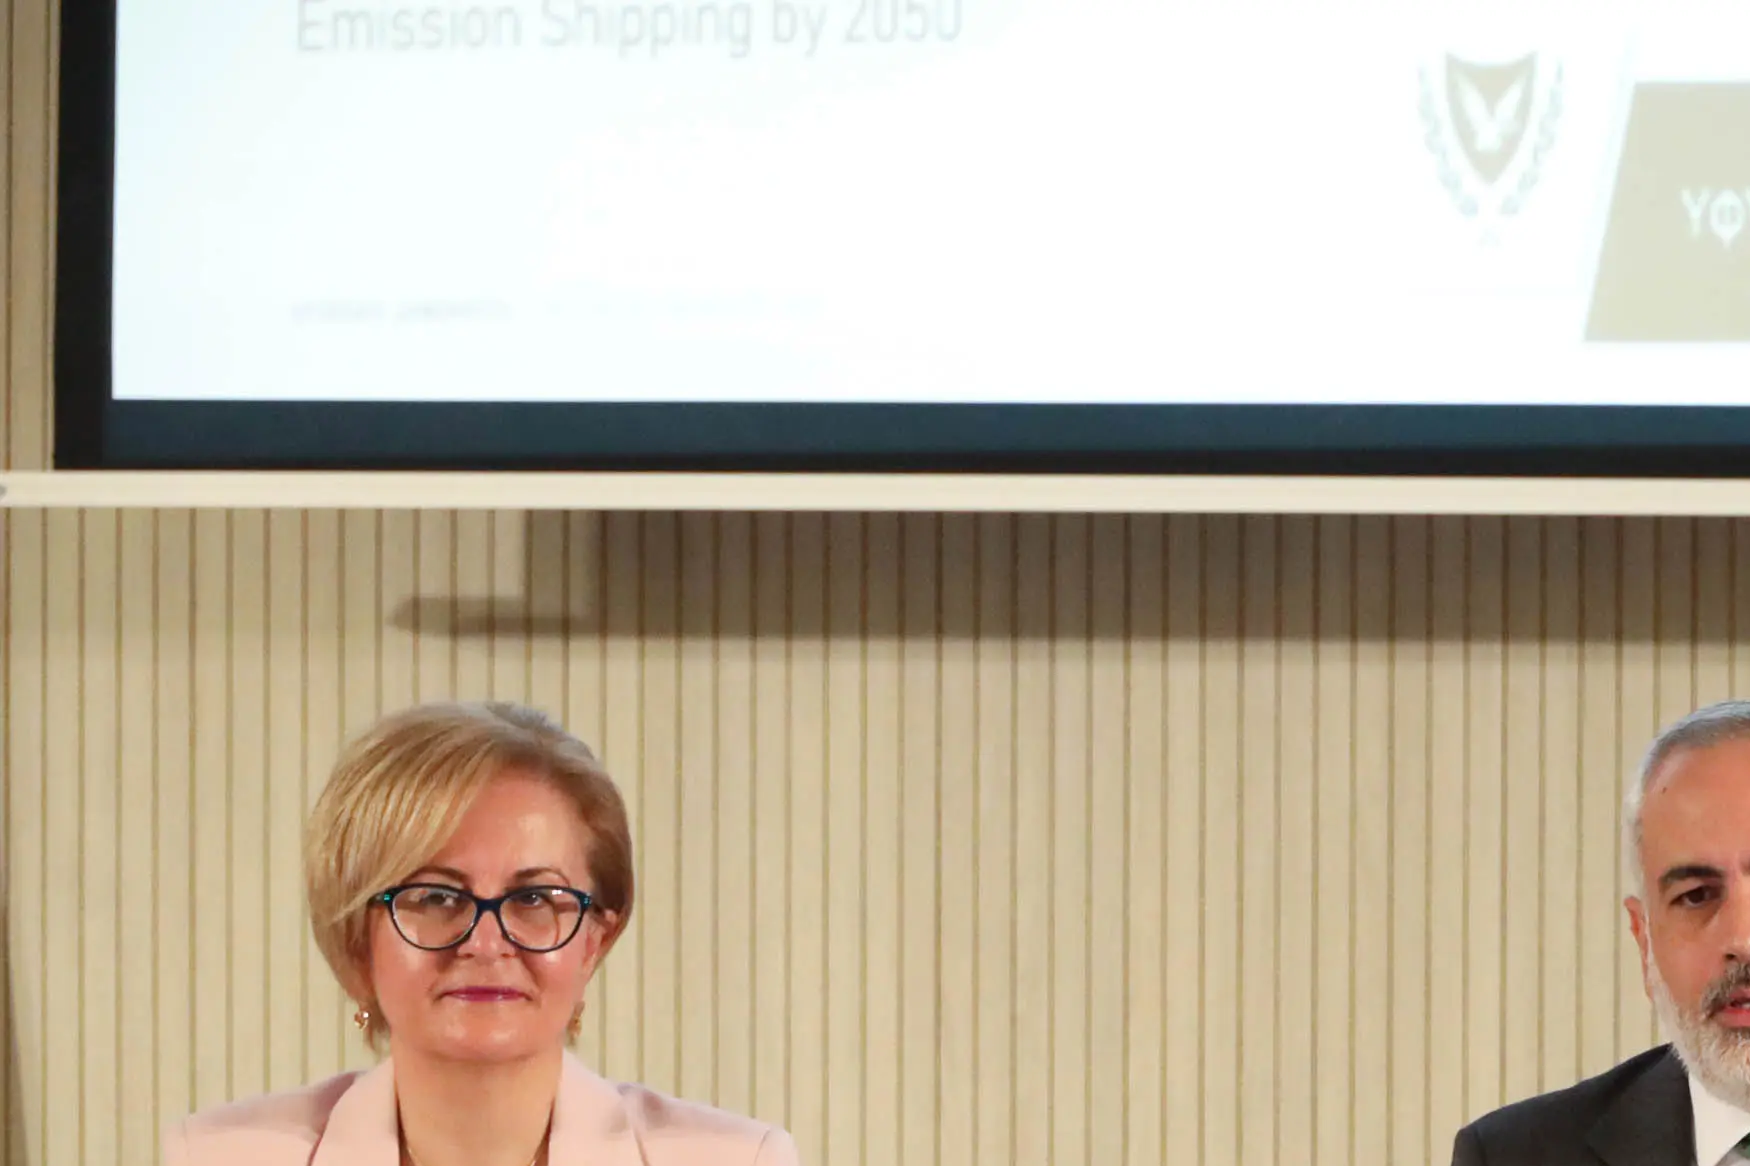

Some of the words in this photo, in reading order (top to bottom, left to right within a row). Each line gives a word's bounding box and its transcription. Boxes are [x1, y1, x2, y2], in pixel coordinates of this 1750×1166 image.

[297, 0, 522, 53] Emission
[541, 0, 754, 58] Shipping
[773, 0, 826, 57] by
[845, 0, 964, 44] 2050
